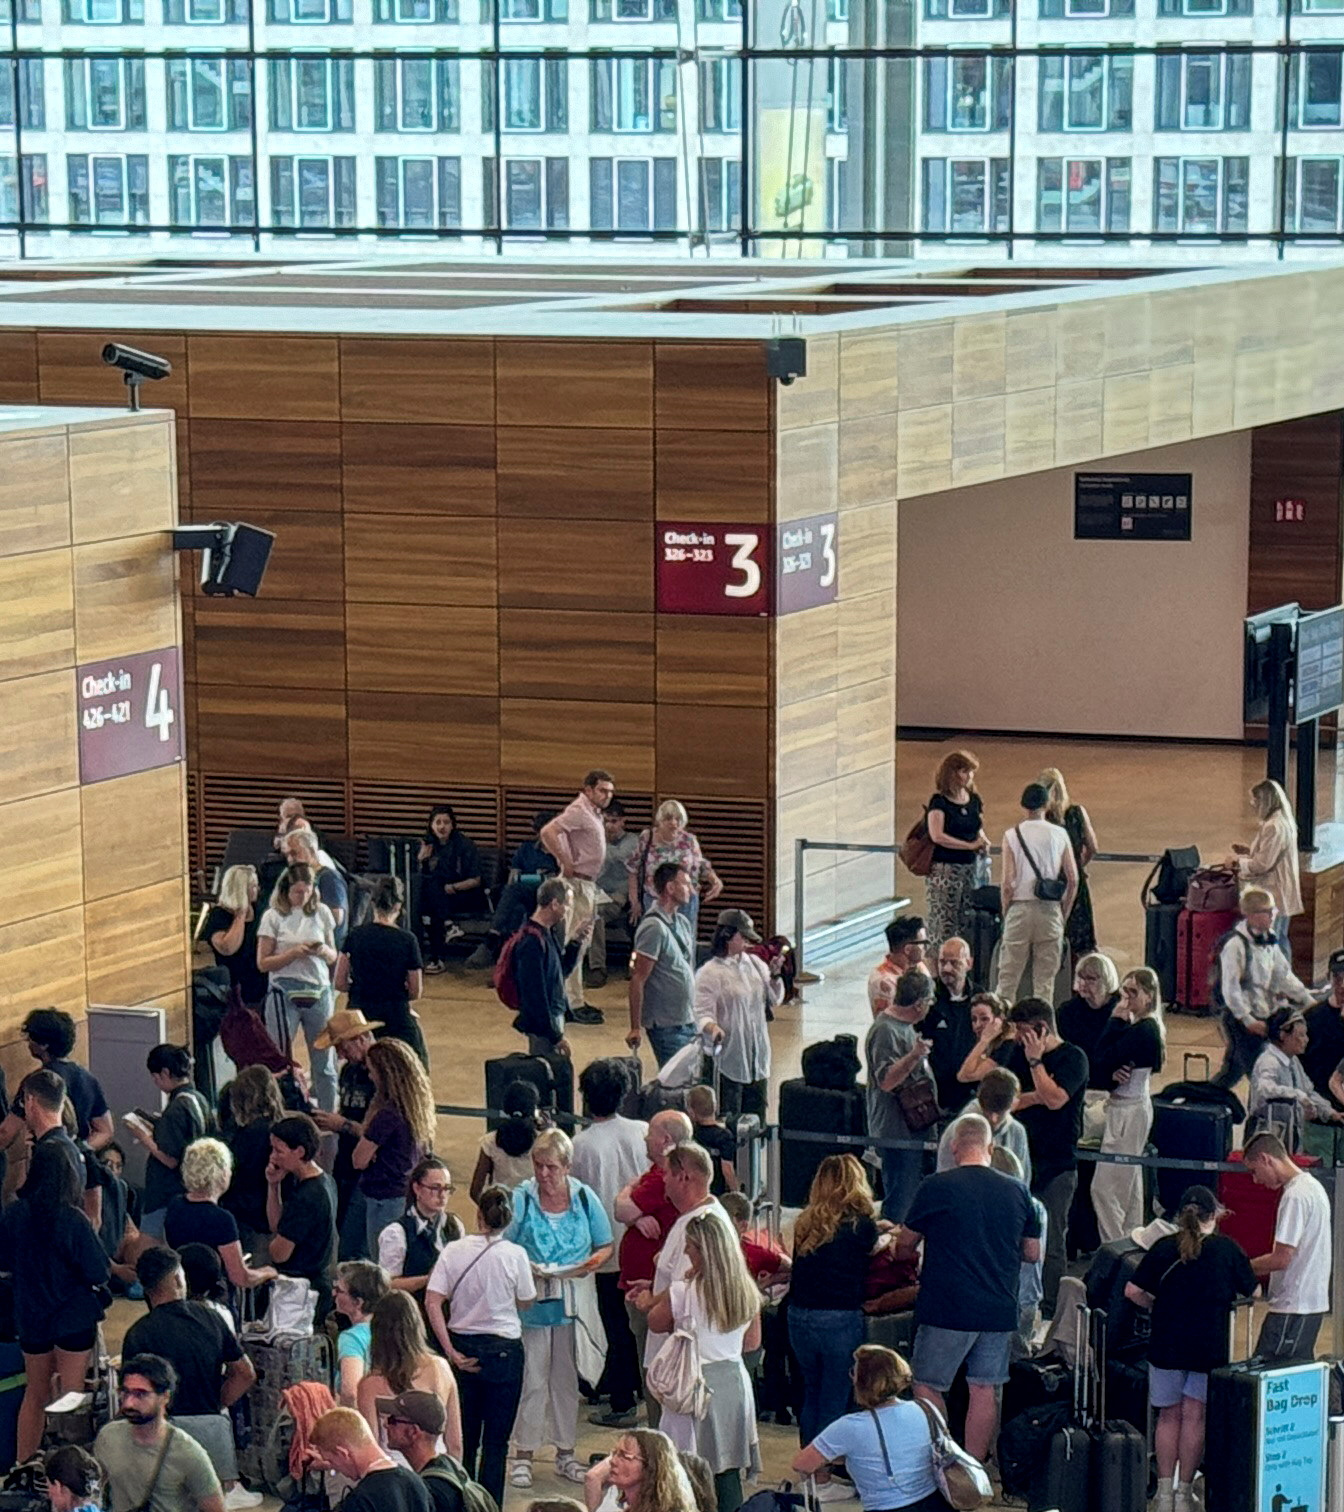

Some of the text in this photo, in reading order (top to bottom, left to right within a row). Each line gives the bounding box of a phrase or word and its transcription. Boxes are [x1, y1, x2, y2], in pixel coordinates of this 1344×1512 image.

[664, 531, 716, 546] Check-in
[724, 533, 761, 598] 3
[820, 523, 836, 588] 3
[82, 668, 132, 699] Check-in
[145, 663, 175, 742] 4
[1266, 1378, 1290, 1395] Fast
[1266, 1393, 1319, 1415] Bag Drop
